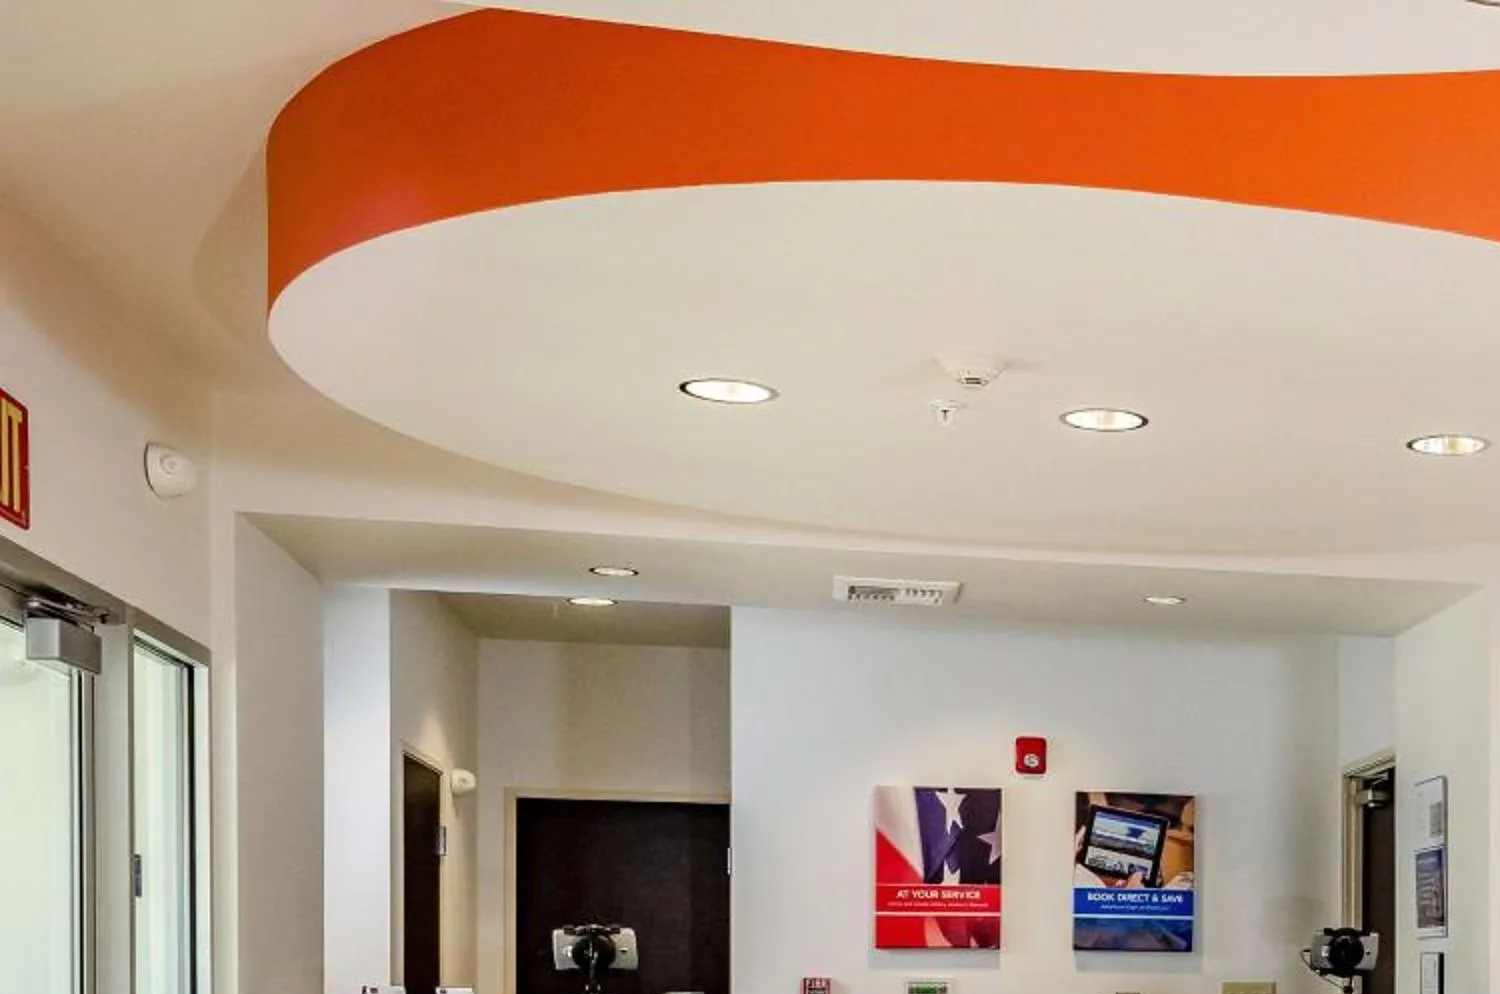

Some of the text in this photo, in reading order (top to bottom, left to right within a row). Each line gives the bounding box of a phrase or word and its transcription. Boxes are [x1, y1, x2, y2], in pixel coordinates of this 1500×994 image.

[896, 889, 981, 900] AT YOUR SERVICE
[1087, 892, 1115, 902] BOOK
[1117, 893, 1150, 903] DIRECT
[1161, 894, 1184, 904] SAVE
